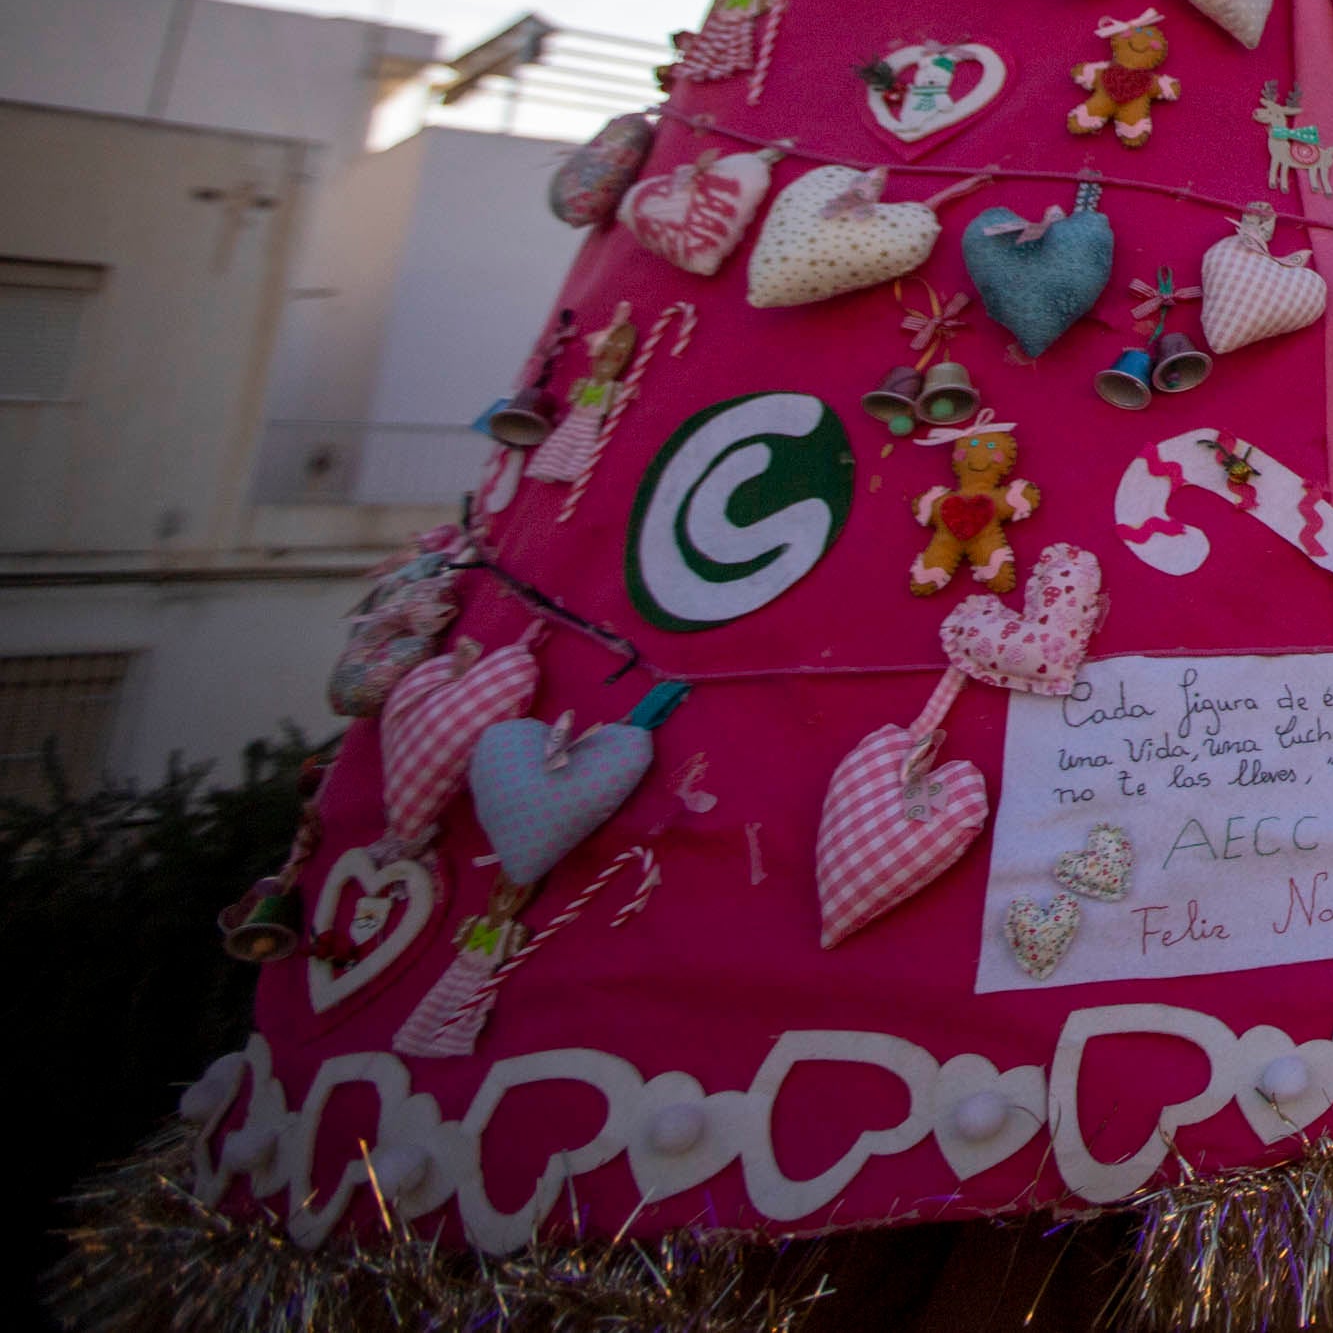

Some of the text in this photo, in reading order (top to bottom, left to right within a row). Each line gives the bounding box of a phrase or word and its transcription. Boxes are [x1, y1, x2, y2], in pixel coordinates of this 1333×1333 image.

[1063, 681, 1156, 728] Cada
[1178, 668, 1259, 739] figura
[1277, 684, 1309, 710] de
[1124, 732, 1199, 763] Vida,
[1053, 788, 1095, 803] no
[1118, 770, 1147, 796] te
[1168, 764, 1211, 788] las
[1162, 816, 1319, 869] AECC
[1131, 899, 1231, 955] Feliz
